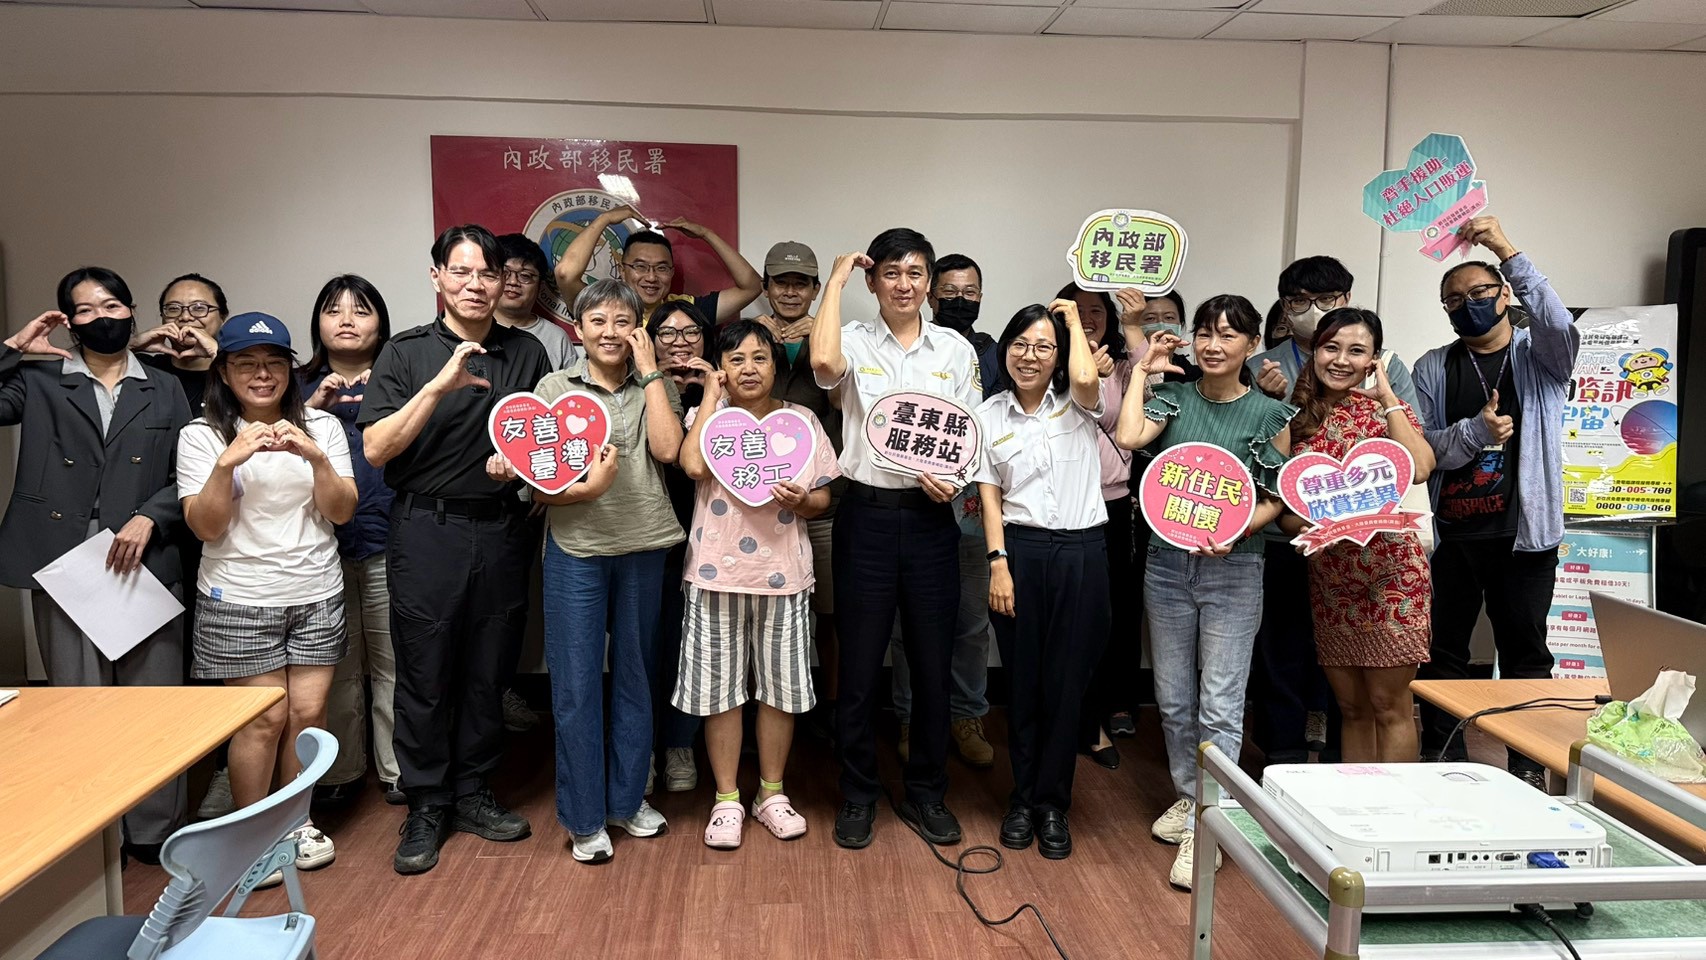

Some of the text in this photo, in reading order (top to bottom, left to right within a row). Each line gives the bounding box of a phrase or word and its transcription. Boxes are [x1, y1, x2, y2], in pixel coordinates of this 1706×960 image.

[504, 145, 667, 174] 內政部移民署
[552, 195, 620, 213] 內政部移民
[1382, 160, 1473, 226] 杜絕人口販運
[1092, 227, 1167, 252] 內政部
[1089, 249, 1162, 274] 移民署
[500, 412, 559, 445] 友善
[891, 401, 969, 437] 臺東縣
[528, 437, 589, 480] 臺灣
[710, 428, 767, 460] 友善
[885, 427, 962, 464] 服務站
[732, 463, 791, 489] 移工
[1158, 460, 1244, 506] 新住民
[1300, 460, 1394, 495] 尊重多元
[1609, 486, 1672, 495] 00-005-788
[1162, 494, 1223, 533] 關懷
[1308, 483, 1401, 521] 欣賞差異
[1595, 503, 1672, 512] 0800-030-068
[1576, 547, 1613, 558] 大好康!
